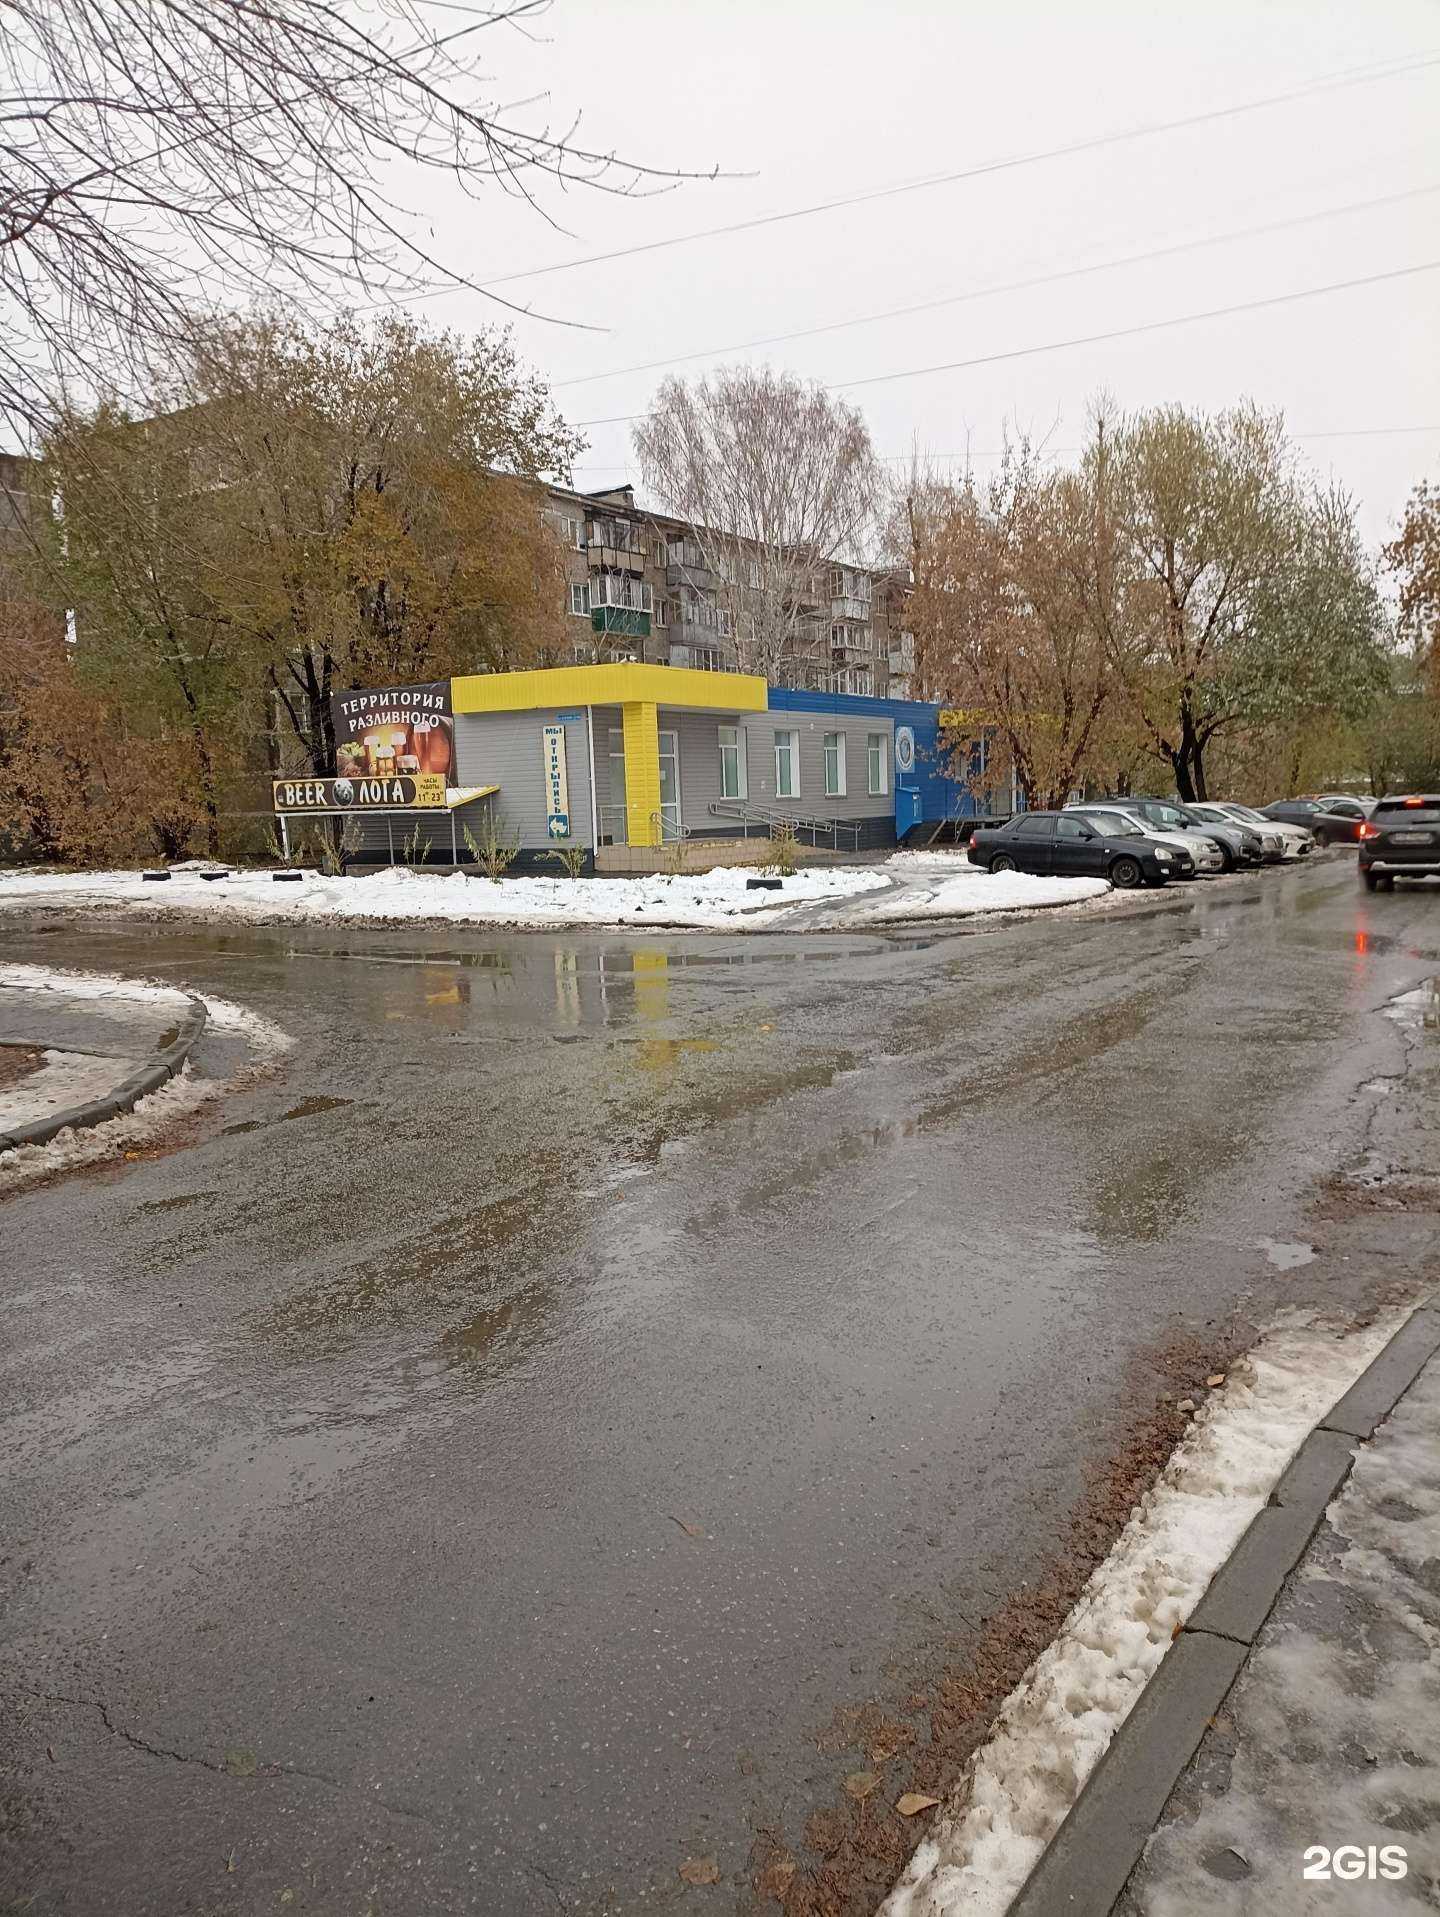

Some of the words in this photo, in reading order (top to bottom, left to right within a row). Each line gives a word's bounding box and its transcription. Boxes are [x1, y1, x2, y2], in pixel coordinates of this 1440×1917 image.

[340, 692, 445, 715] ТЕРРИТОРИЯ
[348, 711, 440, 733] РАЗЛИВНОГО
[284, 782, 328, 806] BEER
[359, 778, 405, 804] ЛОГА
